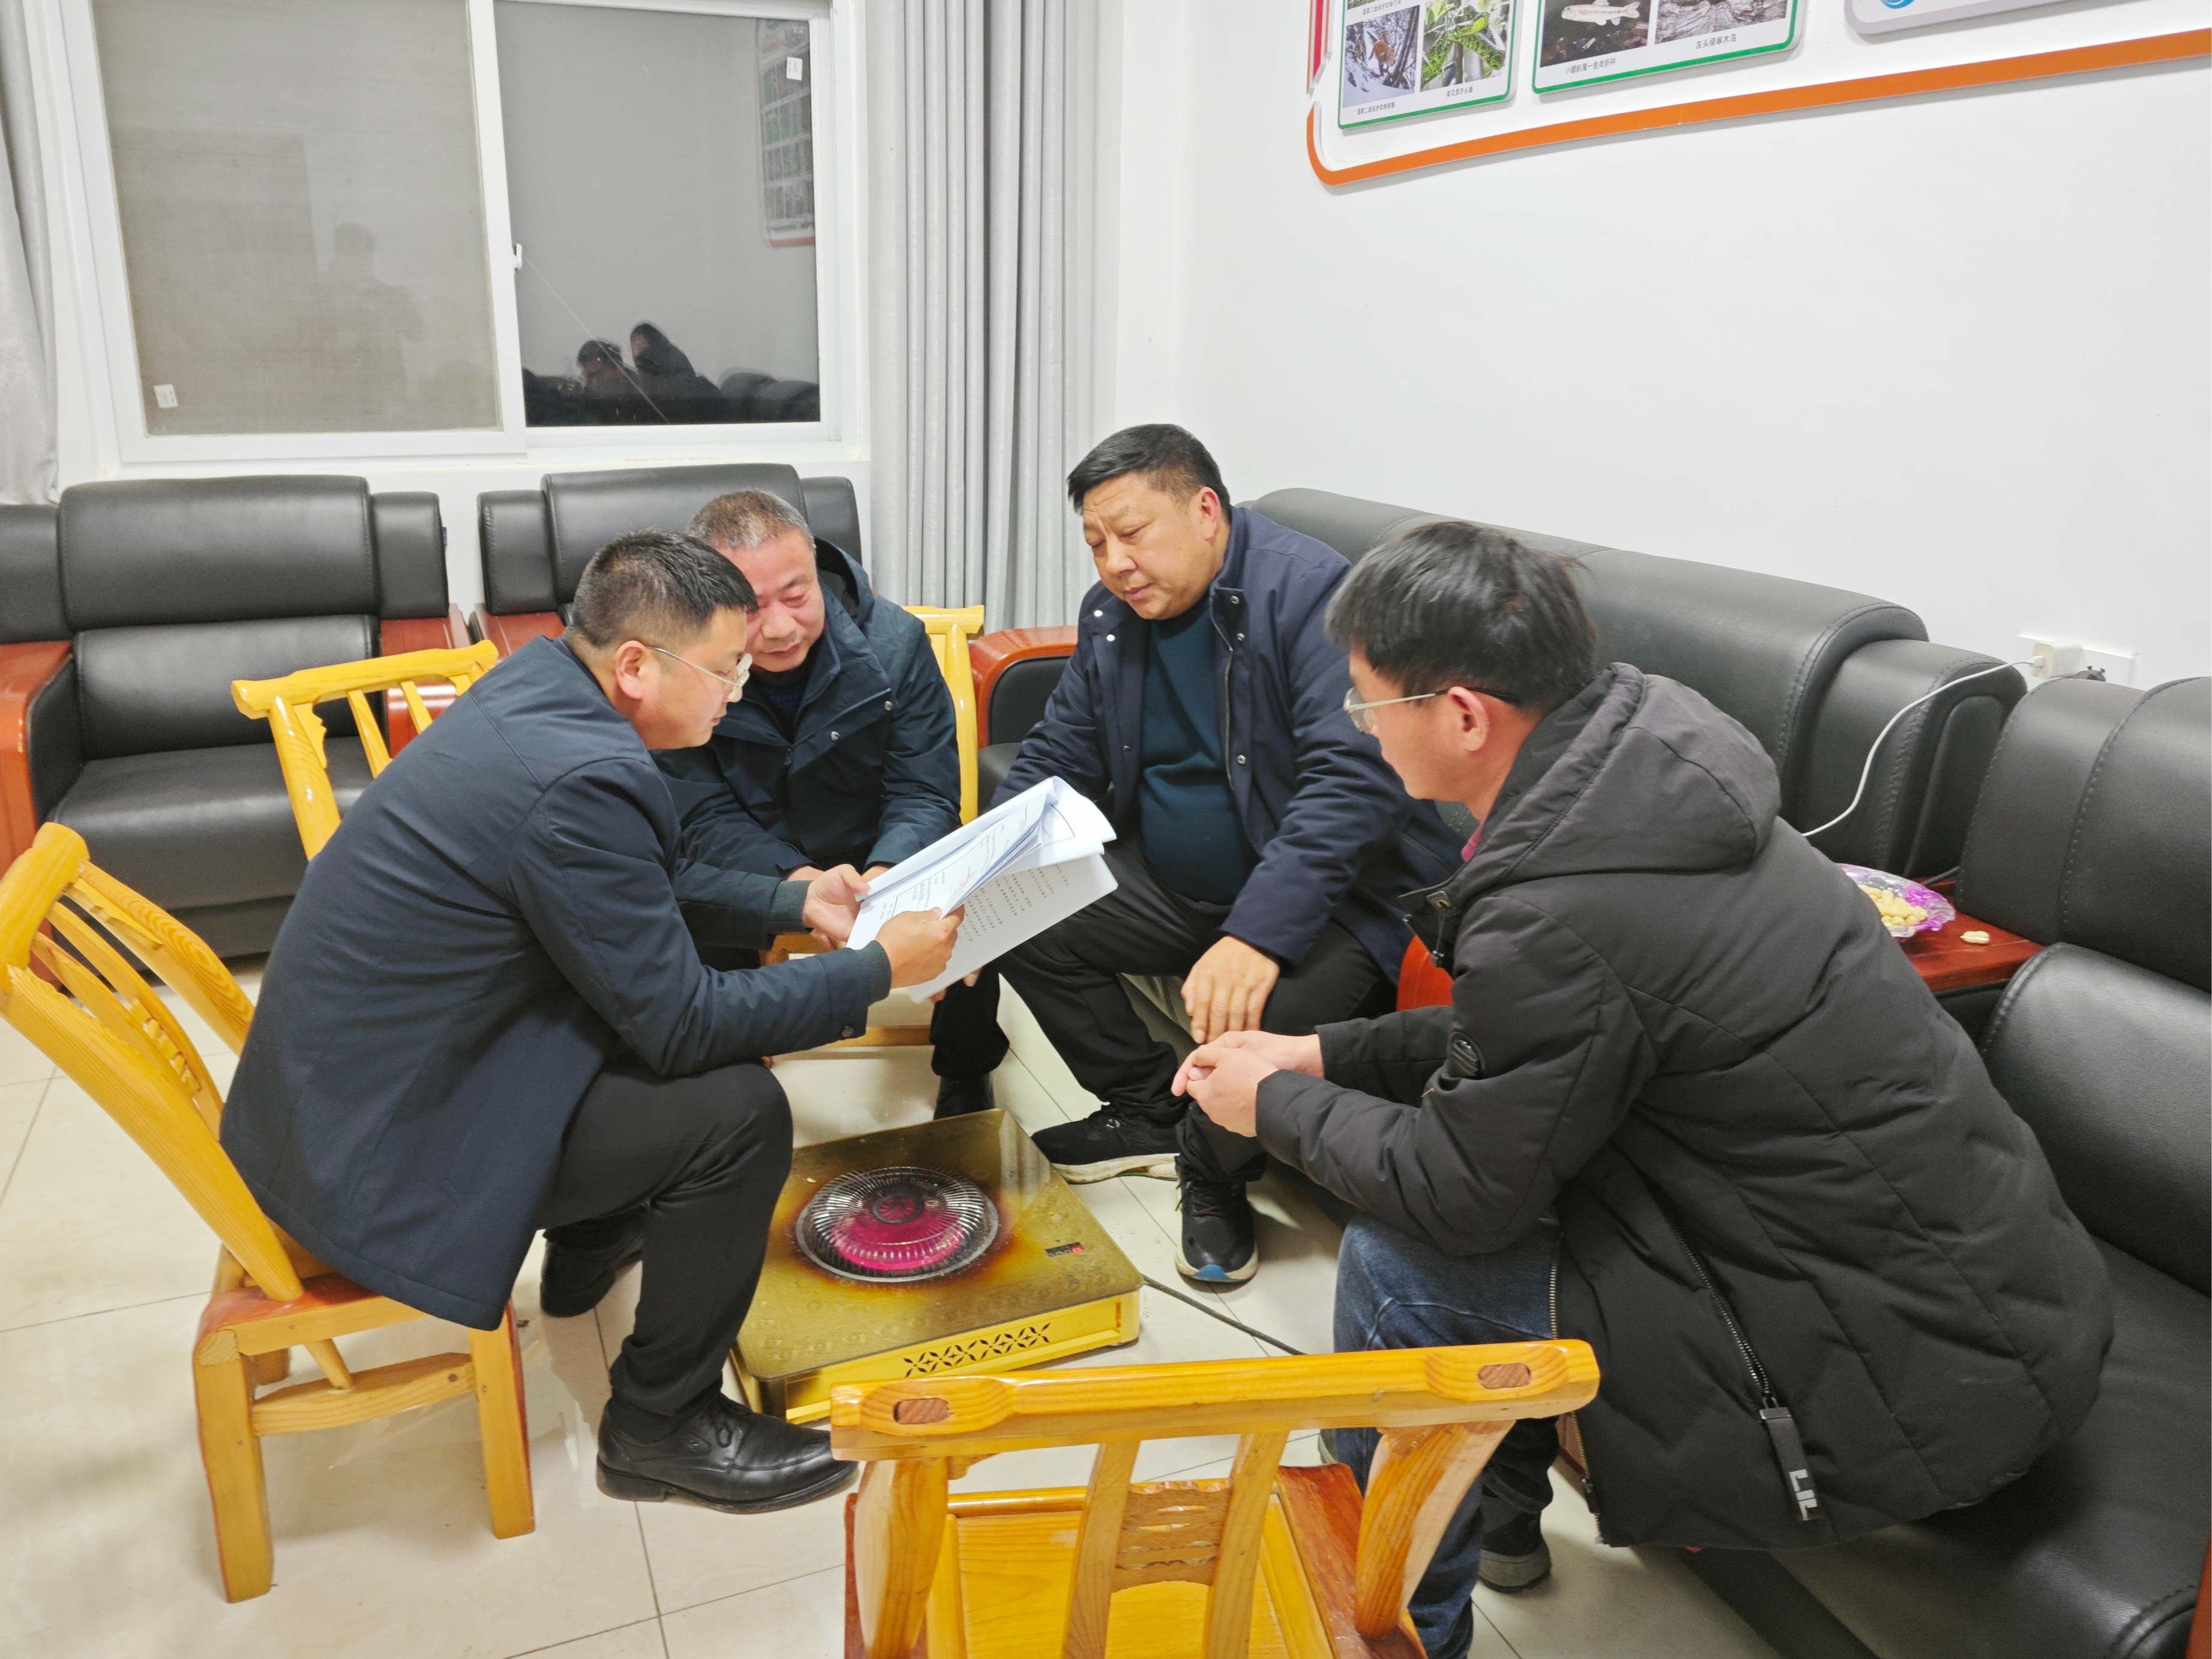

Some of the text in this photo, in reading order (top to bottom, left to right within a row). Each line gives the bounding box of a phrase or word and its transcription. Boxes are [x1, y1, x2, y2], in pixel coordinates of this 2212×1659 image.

[1695, 34, 1737, 49] 灰头绿啄木鸟
